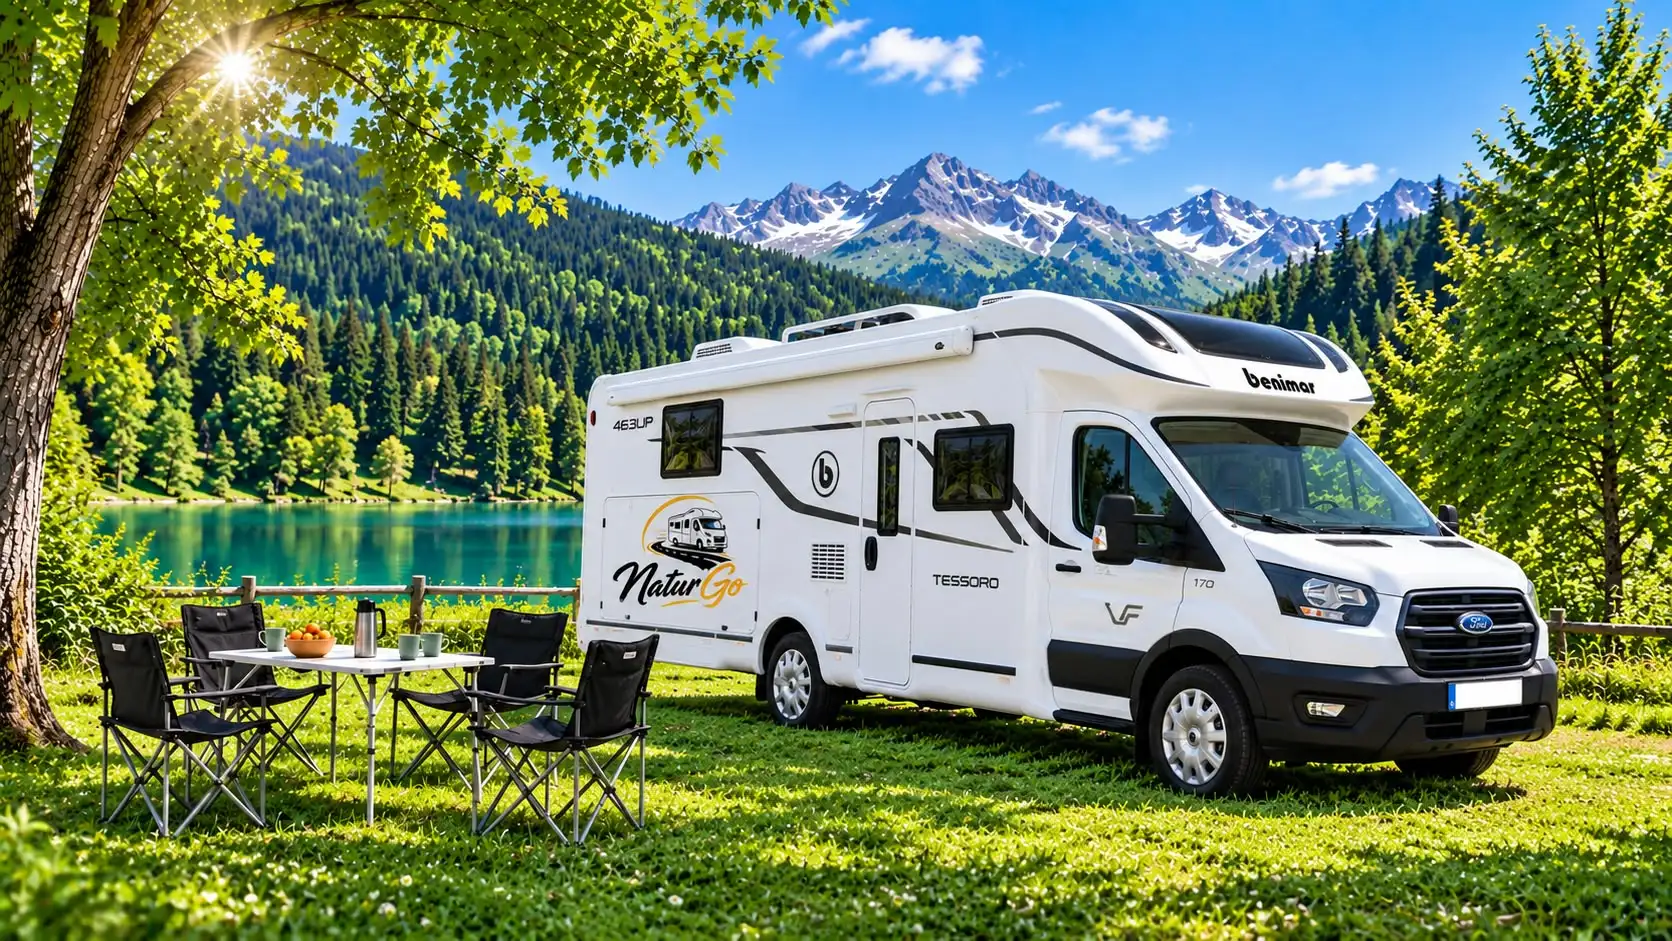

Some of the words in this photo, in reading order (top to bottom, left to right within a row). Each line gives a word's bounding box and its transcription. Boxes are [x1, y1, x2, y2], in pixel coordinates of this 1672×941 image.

[1242, 368, 1315, 394] benimar
[613, 416, 654, 431] 463UP
[932, 574, 999, 589] TESSORO
[1194, 578, 1215, 588] 170
